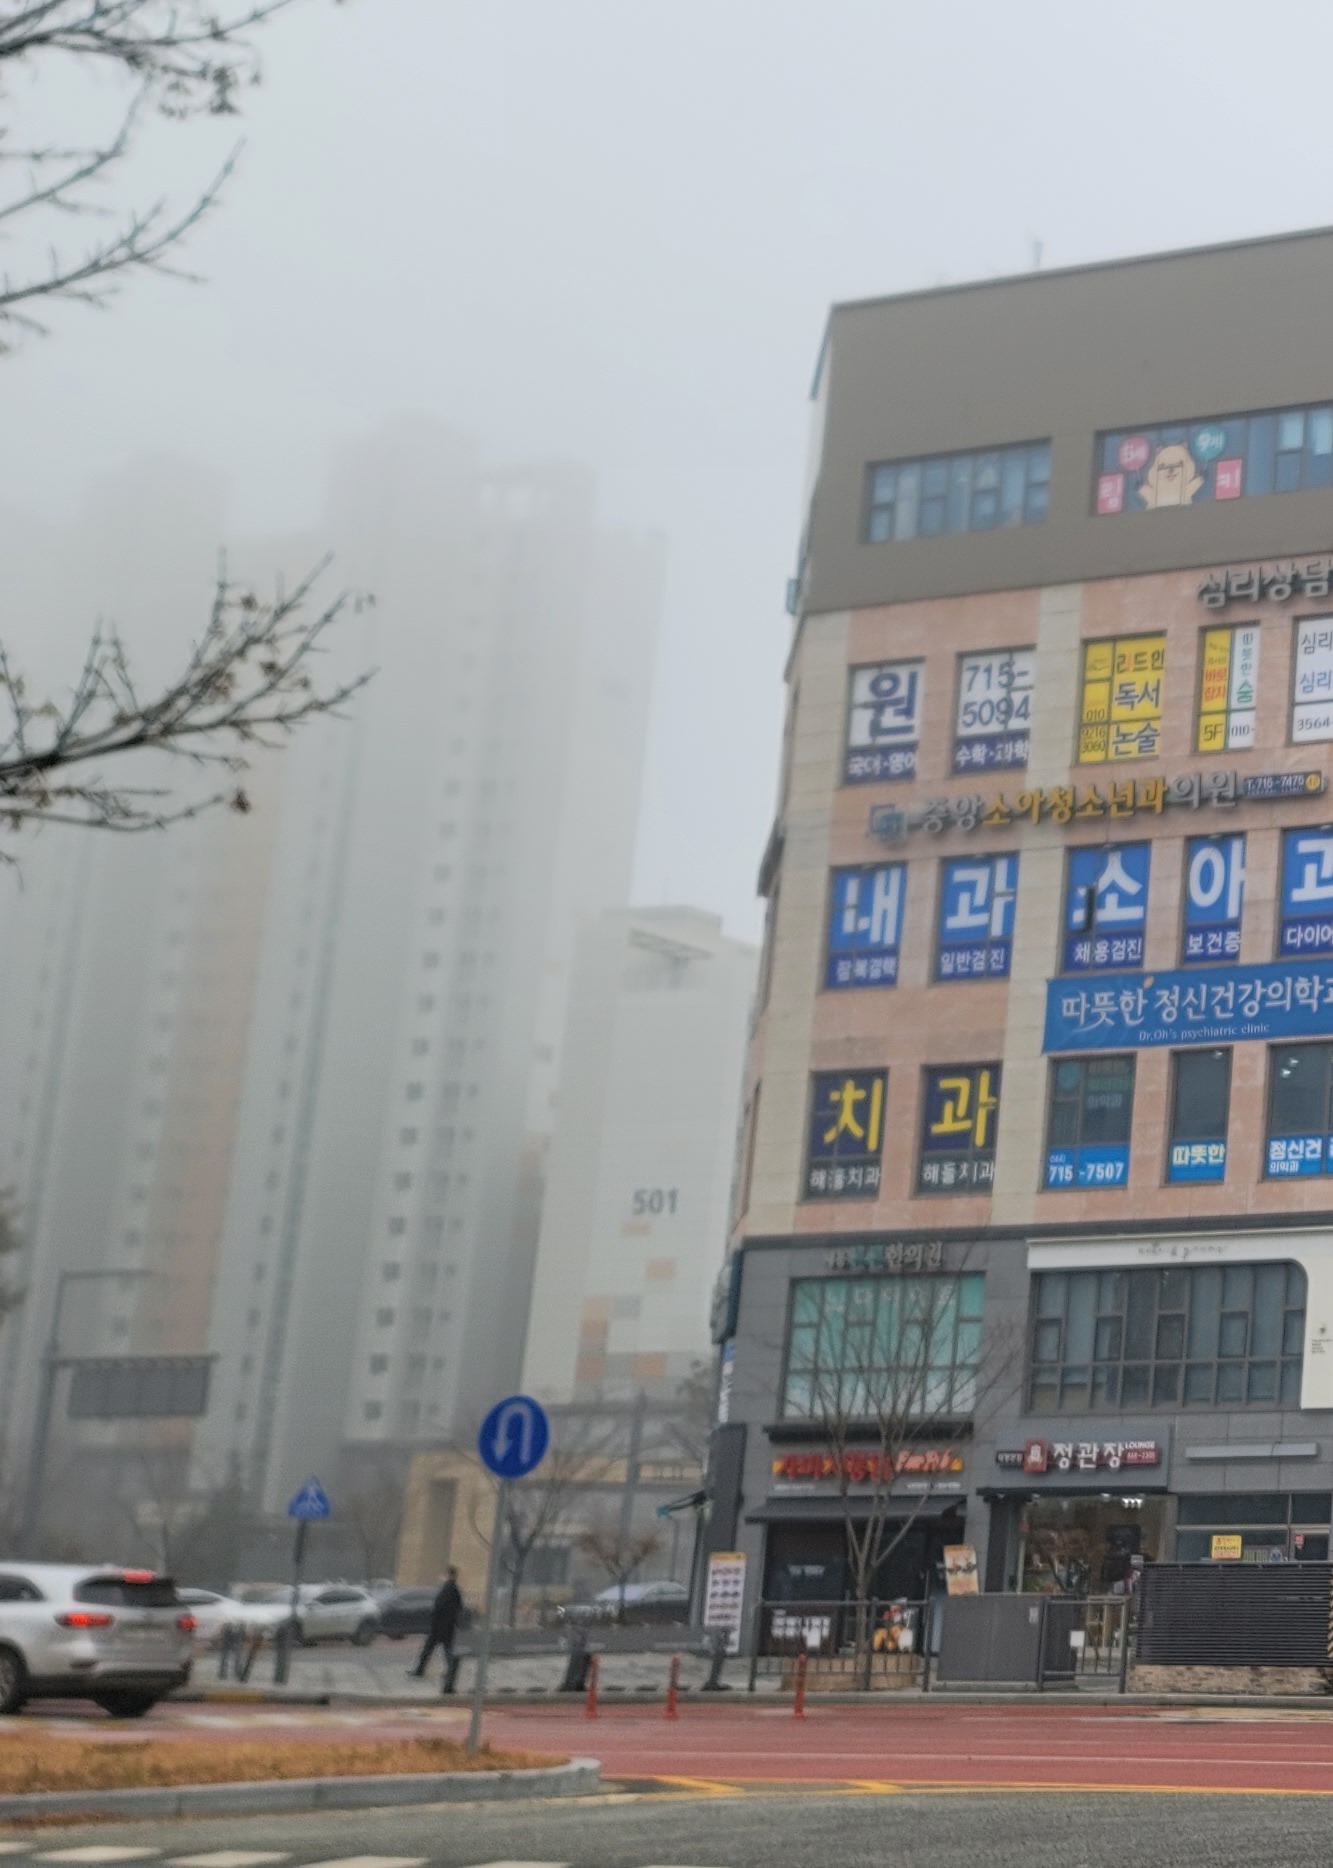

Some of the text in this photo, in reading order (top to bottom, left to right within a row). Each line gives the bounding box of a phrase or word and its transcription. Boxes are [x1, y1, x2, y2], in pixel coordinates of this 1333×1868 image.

[869, 670, 918, 737] 원
[843, 867, 902, 945] 내
[946, 858, 1015, 937] 과
[1189, 839, 1246, 919] 아
[1061, 987, 1147, 1028] 따뜻한
[824, 1070, 997, 1151] 치 과
[632, 1188, 679, 1216] 501
[1052, 1441, 1123, 1469] 정관장
